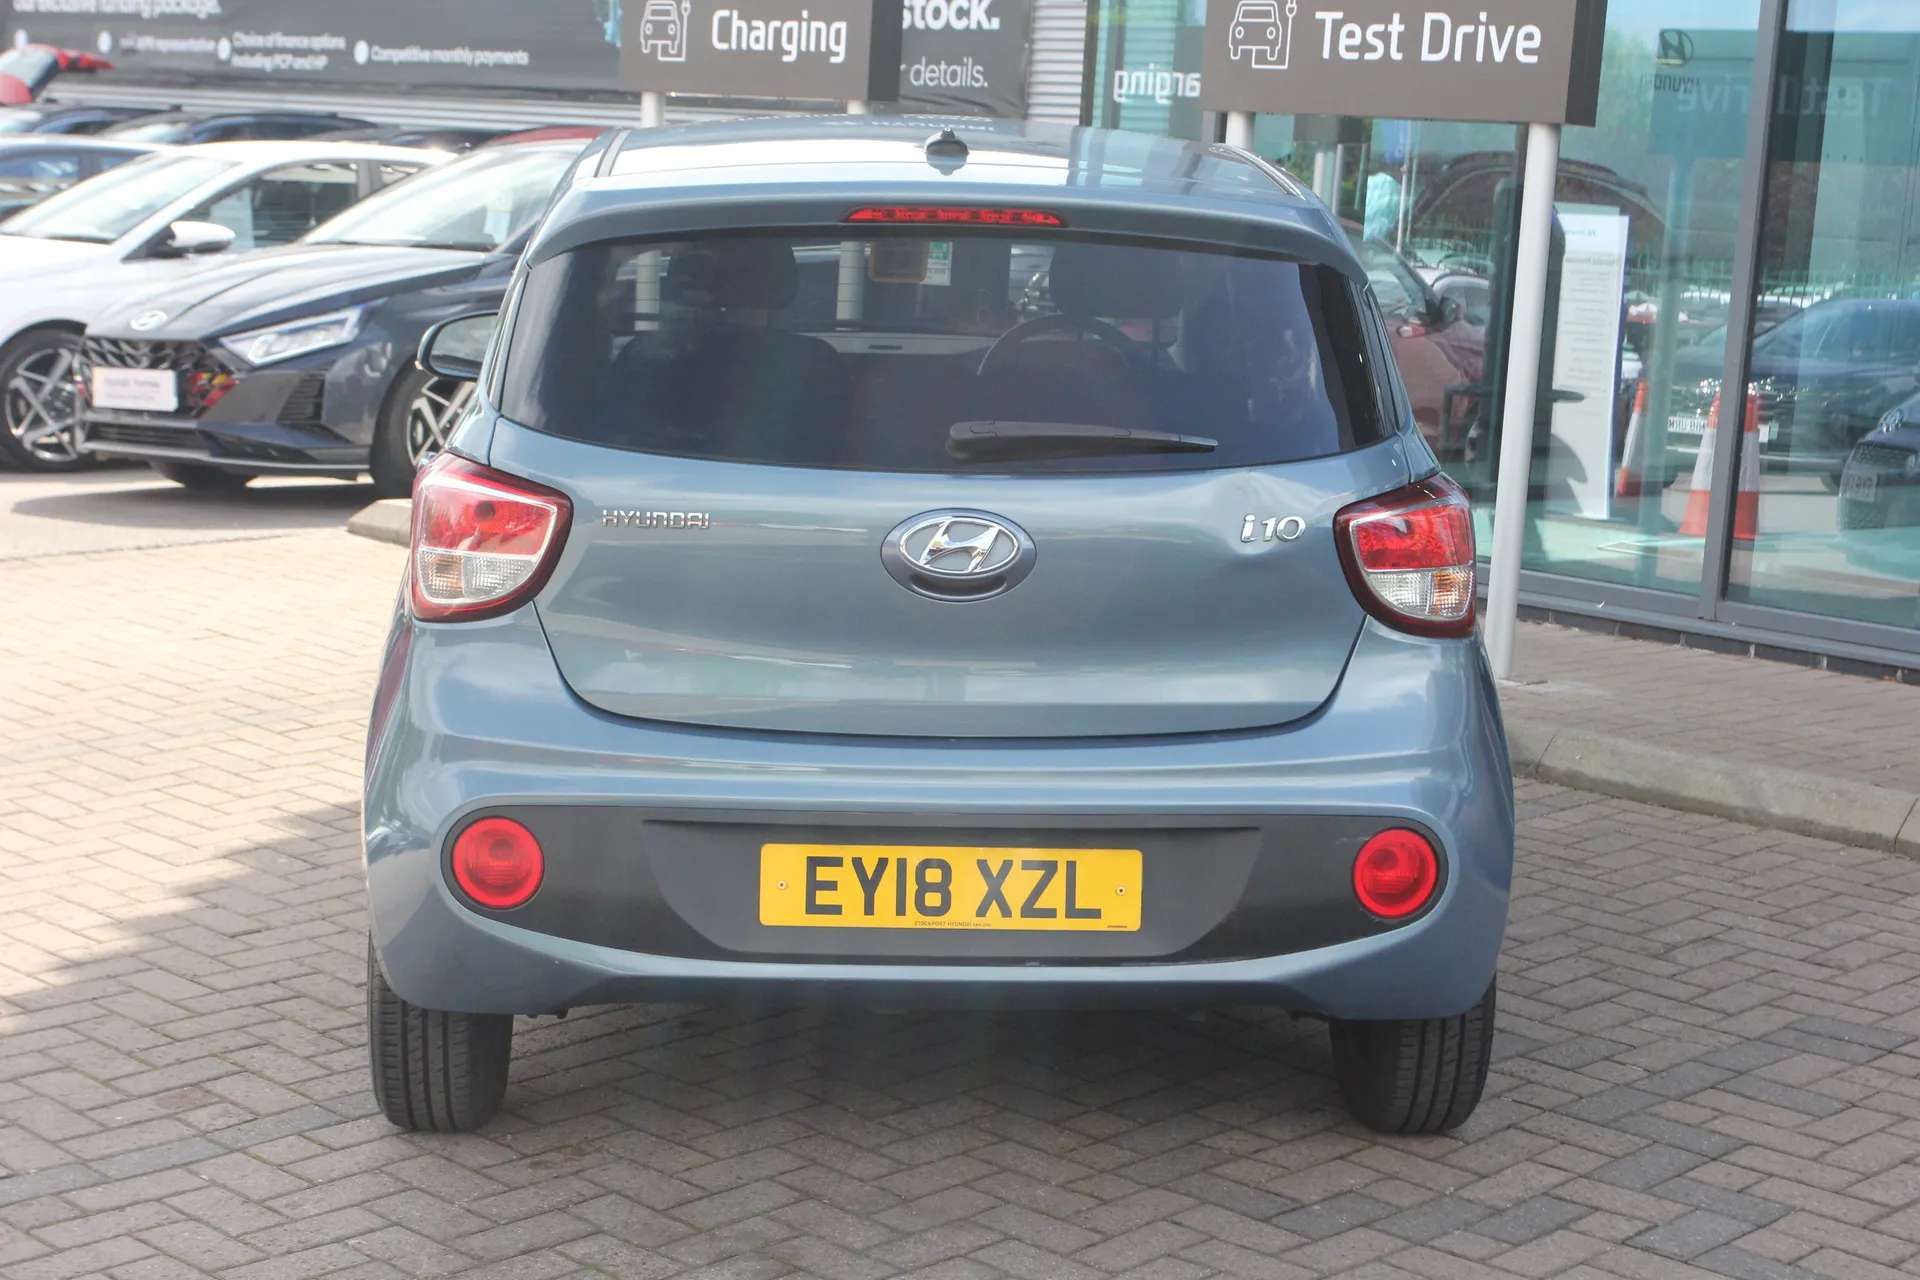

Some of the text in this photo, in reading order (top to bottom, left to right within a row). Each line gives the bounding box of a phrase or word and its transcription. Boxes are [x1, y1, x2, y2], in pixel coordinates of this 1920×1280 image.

[711, 10, 847, 64] Charging
[1315, 12, 1542, 64] Test Drive
[910, 55, 988, 88] details.
[602, 509, 710, 528] HYUNDAI
[1241, 514, 1306, 542] i10
[805, 855, 1102, 920] EY18 XZL
